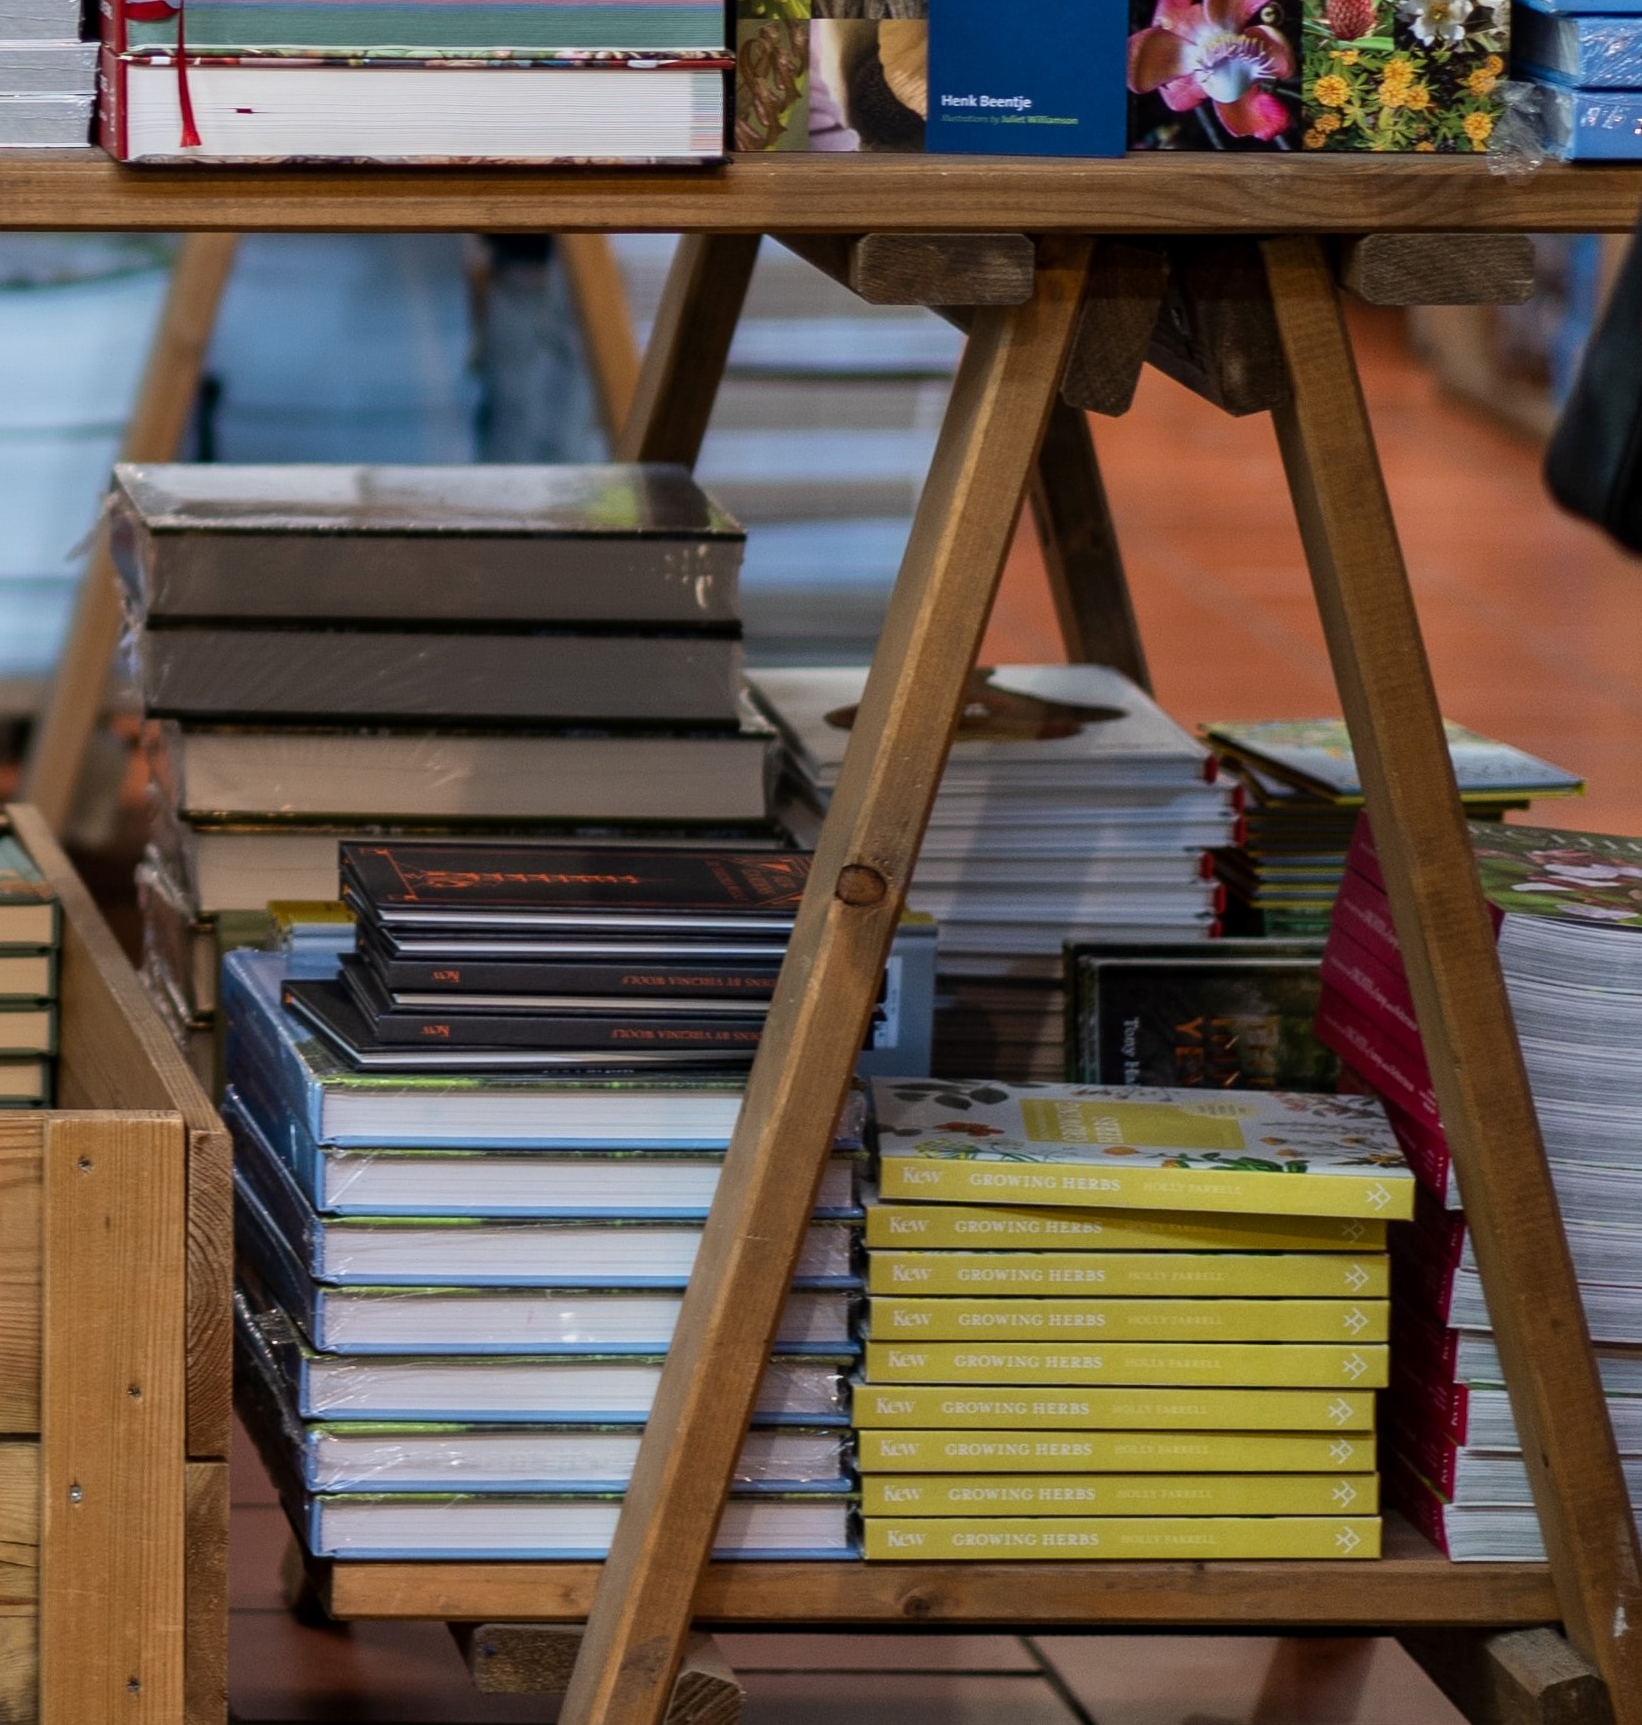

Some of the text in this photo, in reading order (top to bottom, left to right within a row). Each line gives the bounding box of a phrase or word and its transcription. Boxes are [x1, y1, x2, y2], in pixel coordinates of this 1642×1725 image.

[941, 94, 1032, 111] Henk Beentje
[1001, 115, 1079, 125] Juliet Williamson
[902, 1166, 943, 1184] Kew
[970, 1173, 1121, 1192] GROWING HERBS
